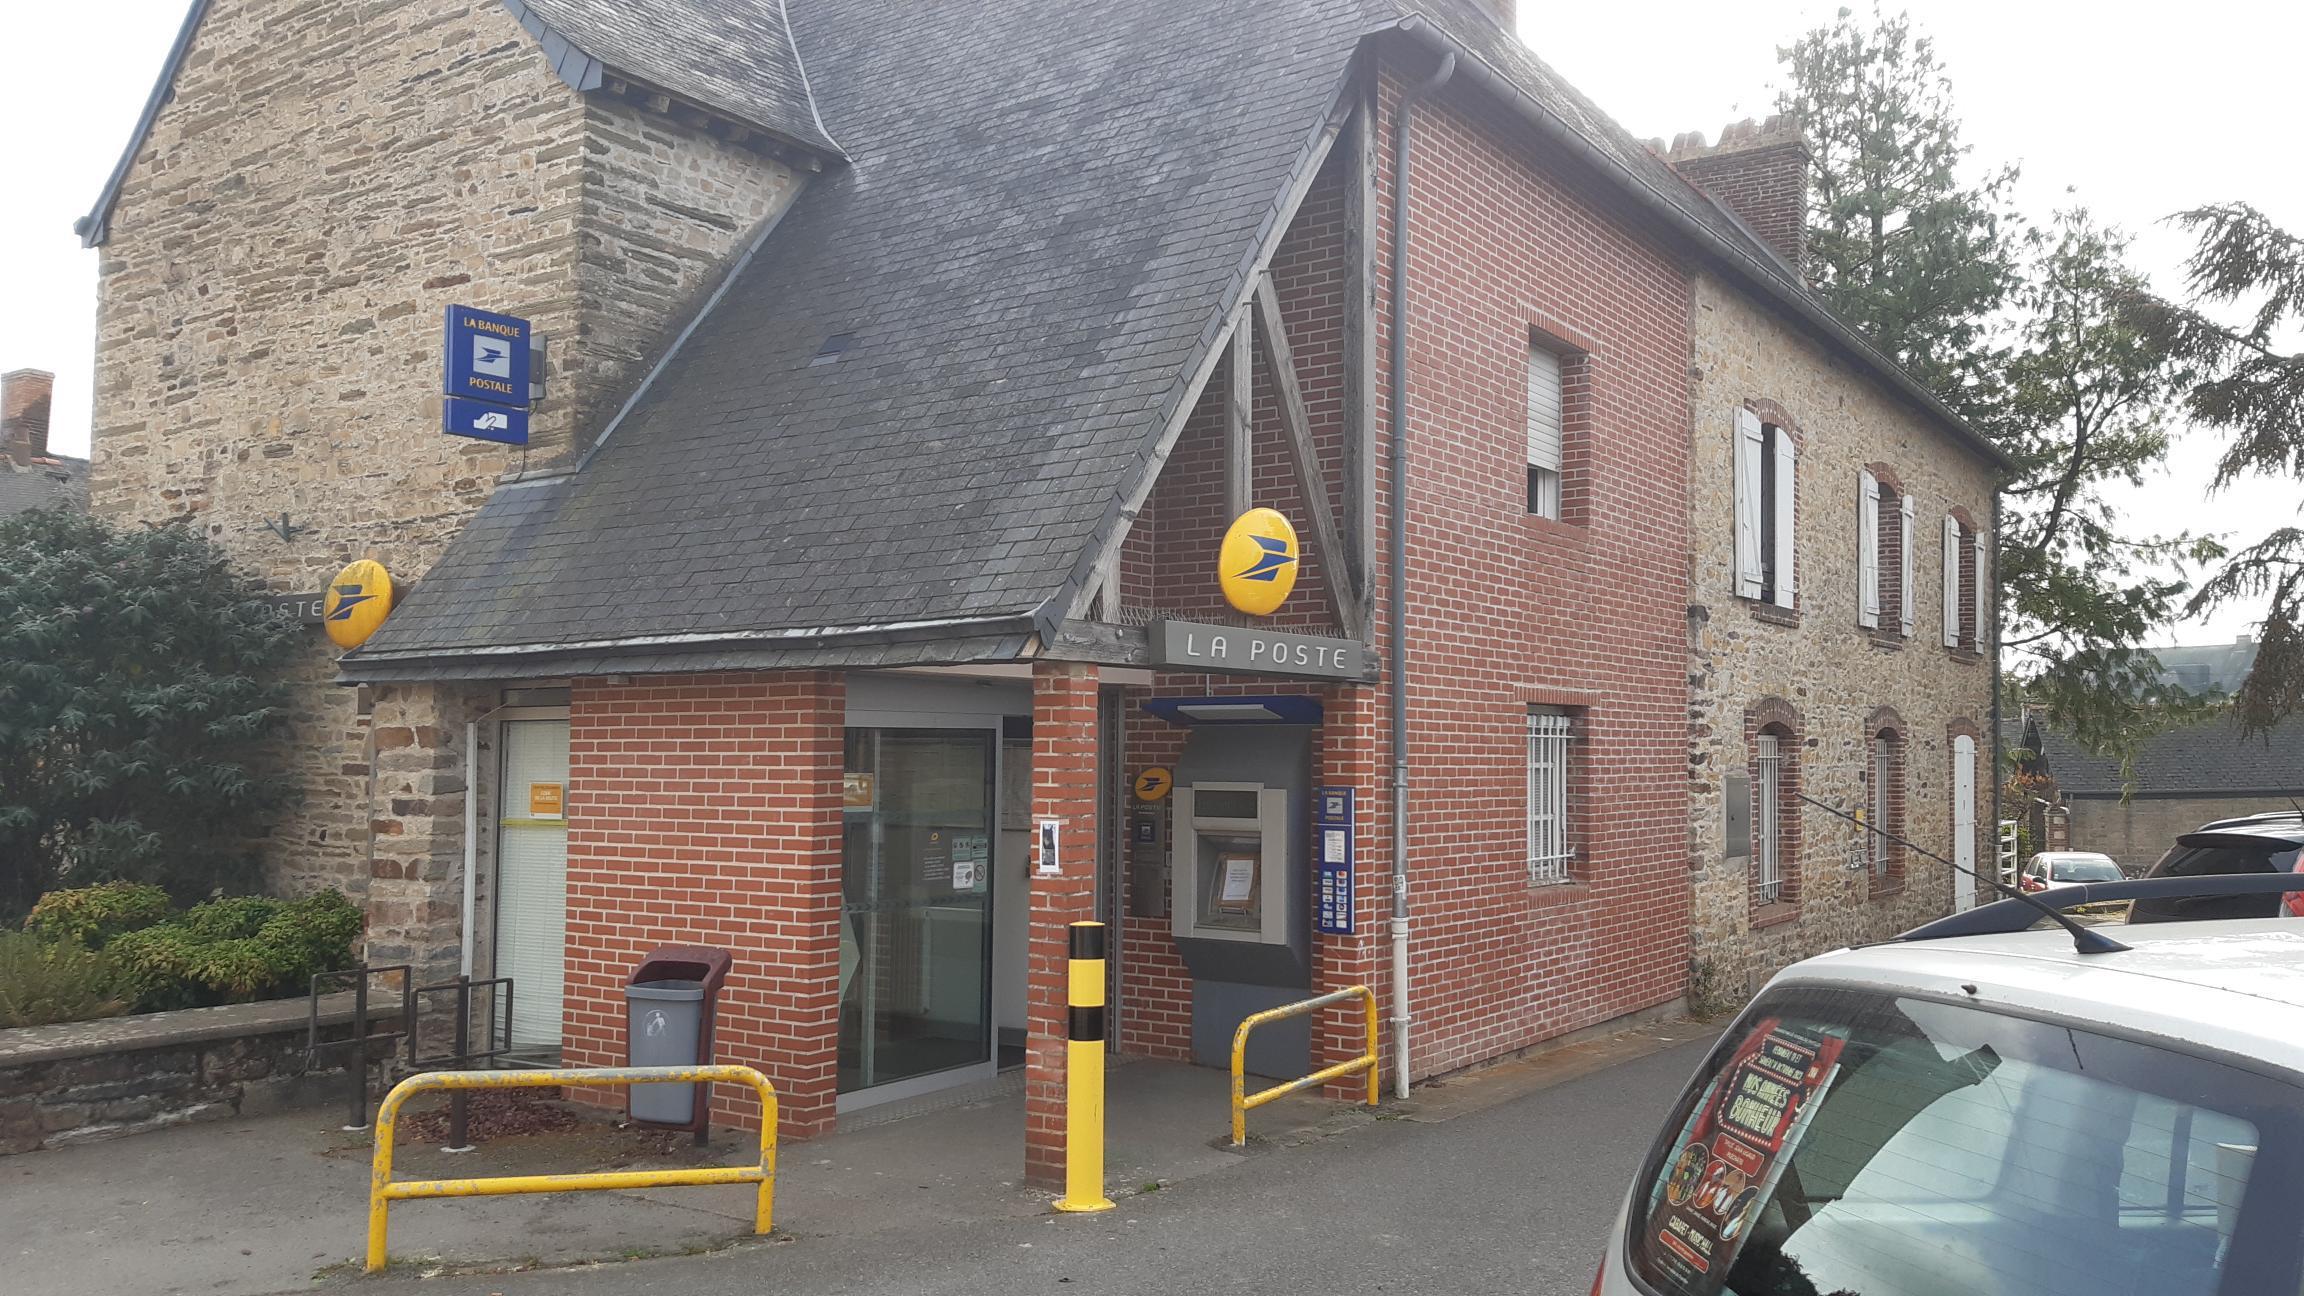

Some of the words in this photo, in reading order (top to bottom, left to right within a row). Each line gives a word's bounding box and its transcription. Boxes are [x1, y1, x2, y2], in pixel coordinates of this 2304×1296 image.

[464, 317, 476, 329] LA
[478, 321, 520, 338] BANQUE
[469, 376, 513, 394] POSTALE
[1187, 633, 1227, 659] LA
[1250, 640, 1347, 669] POSTE
[1742, 1073, 1763, 1095] NOS
[1729, 1095, 1782, 1137] BONHEUR
